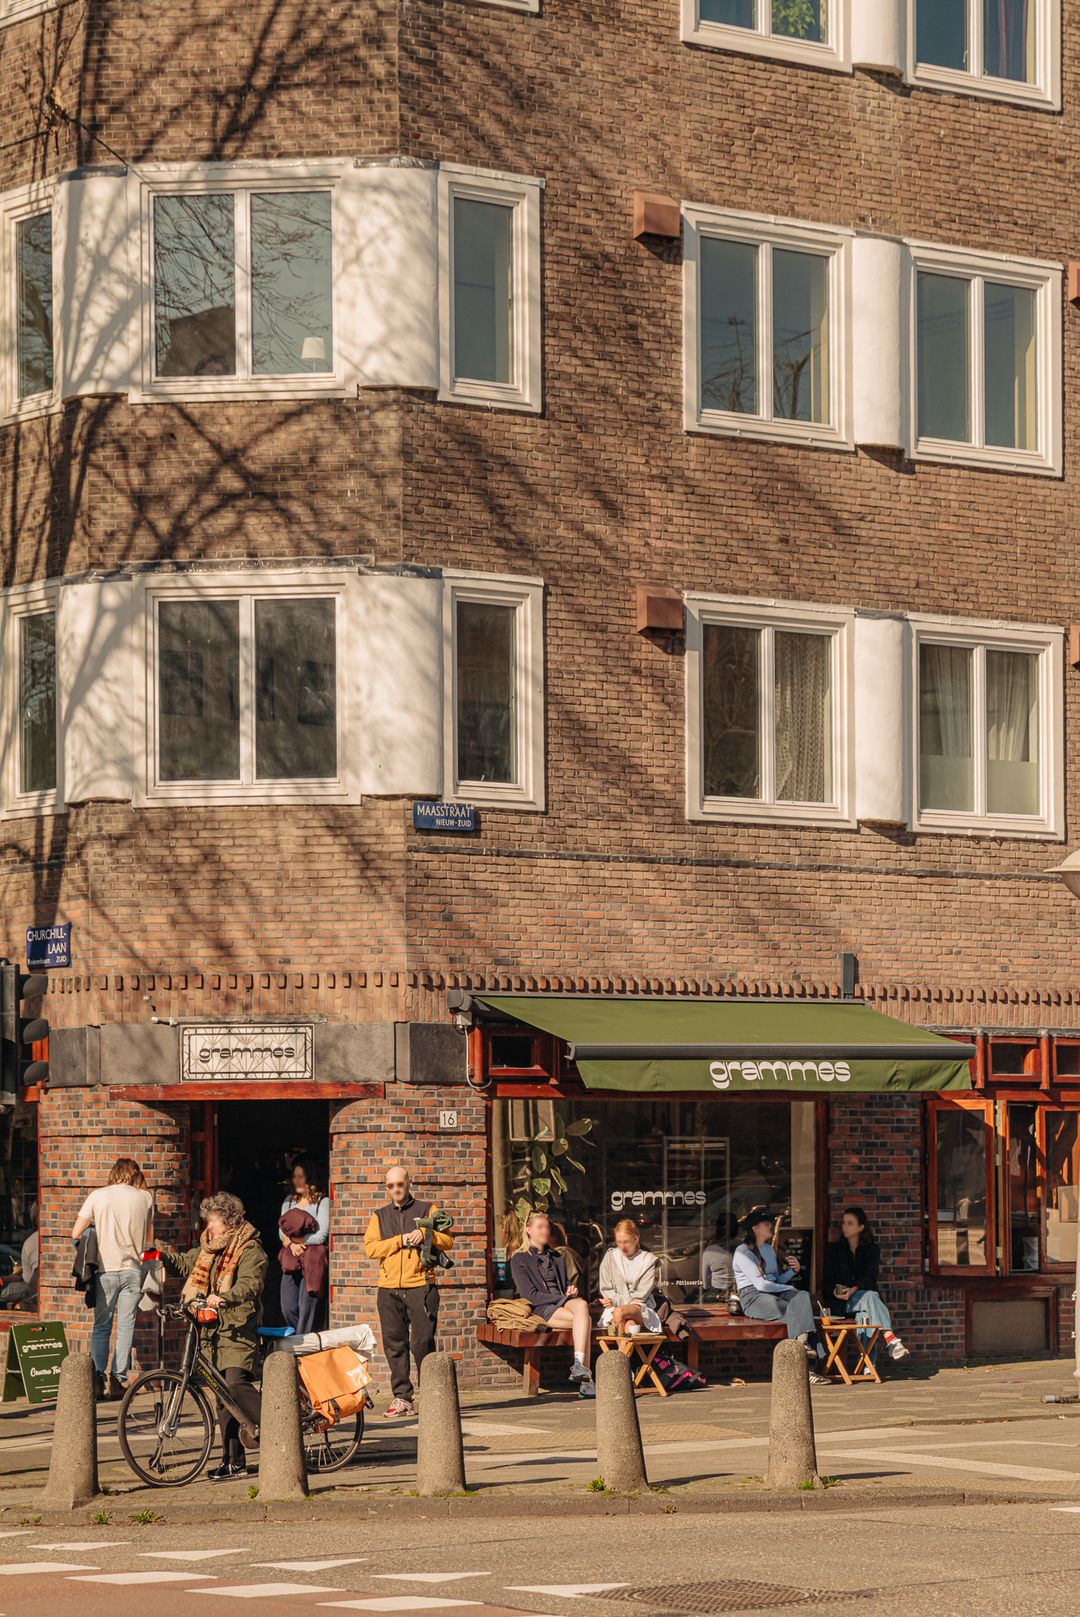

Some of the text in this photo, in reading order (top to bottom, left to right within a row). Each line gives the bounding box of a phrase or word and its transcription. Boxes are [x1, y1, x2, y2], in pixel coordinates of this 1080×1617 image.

[416, 804, 471, 817] MAASSTRAAT
[435, 818, 472, 828] NIEUW-ZUID
[27, 927, 67, 942] CHURCHILL-
[47, 942, 67, 955] LAAN
[55, 955, 67, 963] ZUID
[199, 1047, 295, 1063] grammes
[709, 1061, 851, 1089] grammes
[443, 1112, 455, 1126] 16
[611, 1190, 707, 1211] grammes
[22, 1342, 64, 1353] grammes
